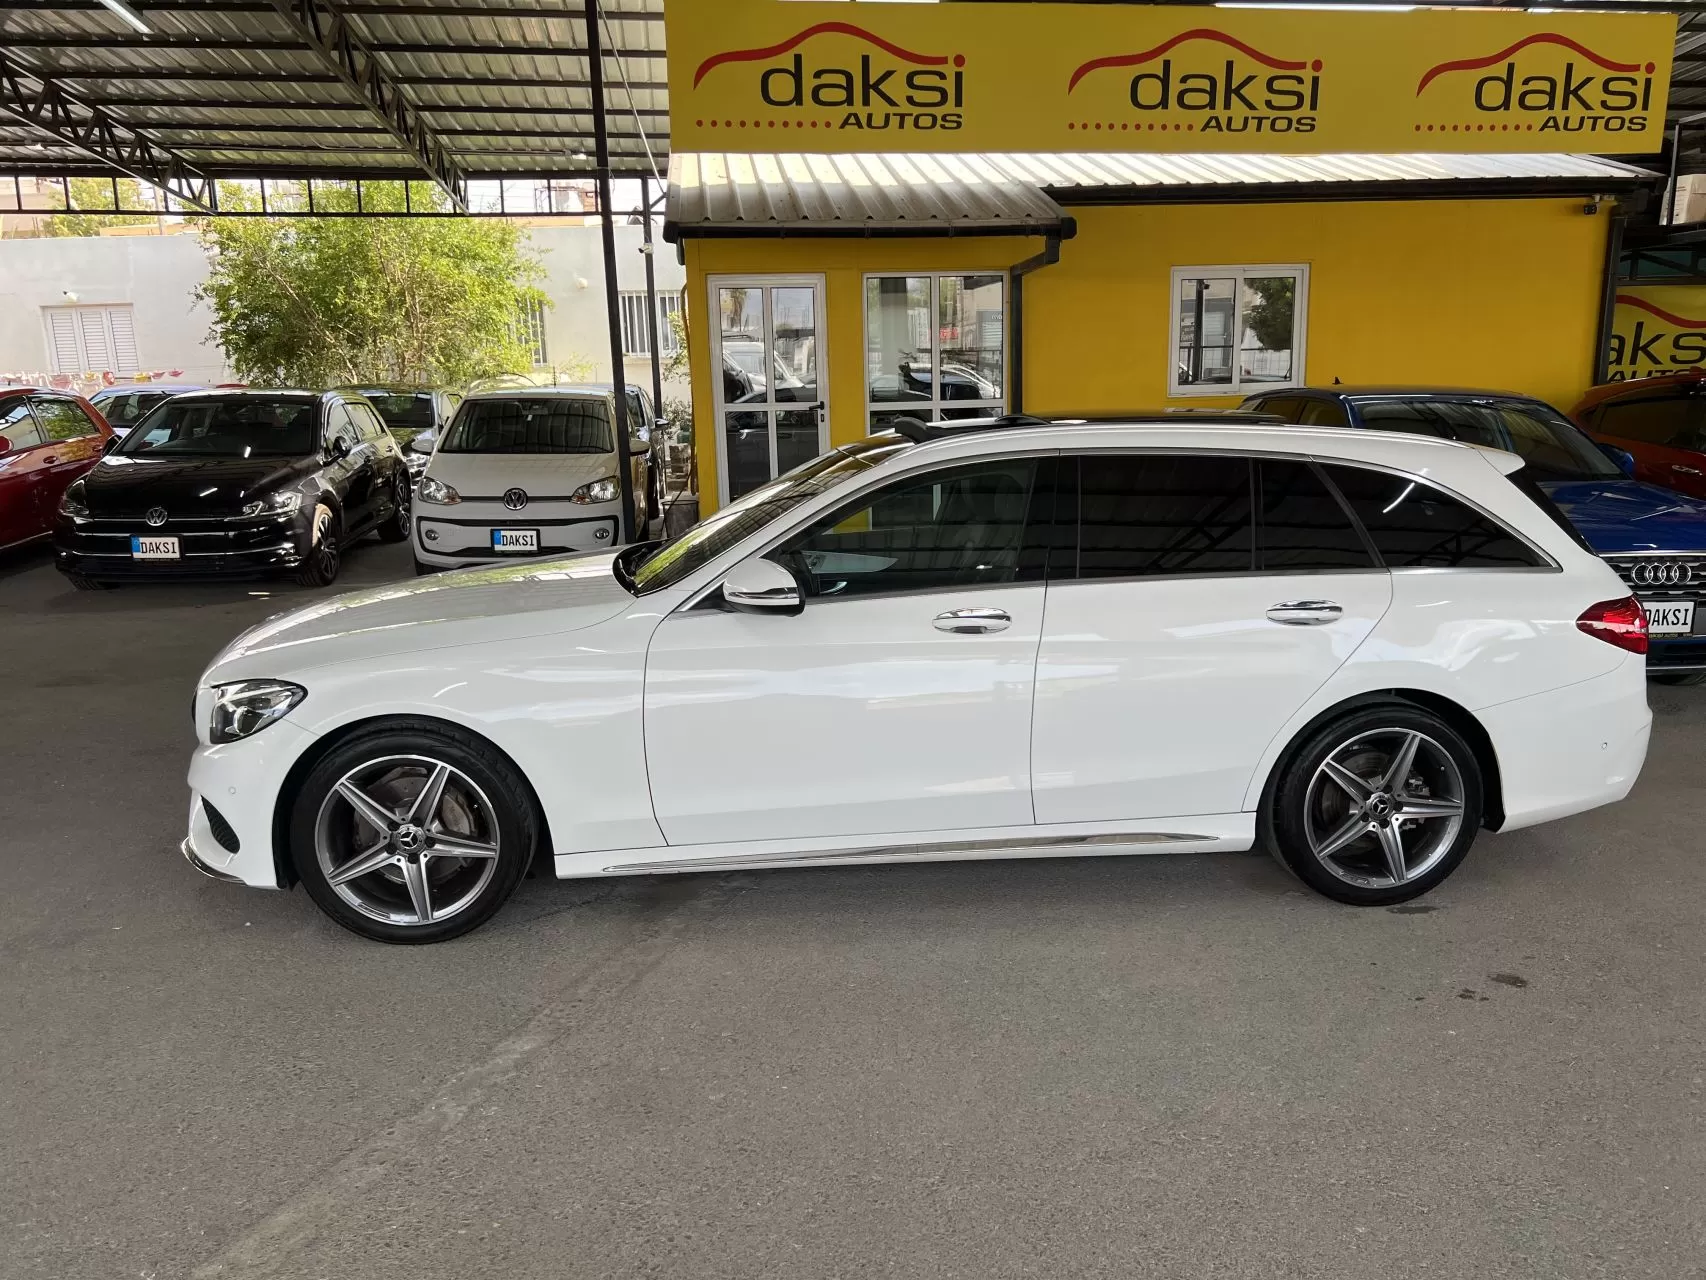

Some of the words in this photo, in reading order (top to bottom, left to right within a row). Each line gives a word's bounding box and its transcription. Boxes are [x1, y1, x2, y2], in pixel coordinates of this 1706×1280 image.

[761, 53, 966, 108] daksi
[1130, 59, 1323, 112] daksi
[1474, 61, 1656, 112] daksi
[839, 112, 963, 130] AUTOS
[1200, 115, 1317, 133] AUTOS
[1538, 115, 1648, 132] AUTOS
[141, 542, 177, 553] DAKSI
[502, 535, 534, 546] DAKSI
